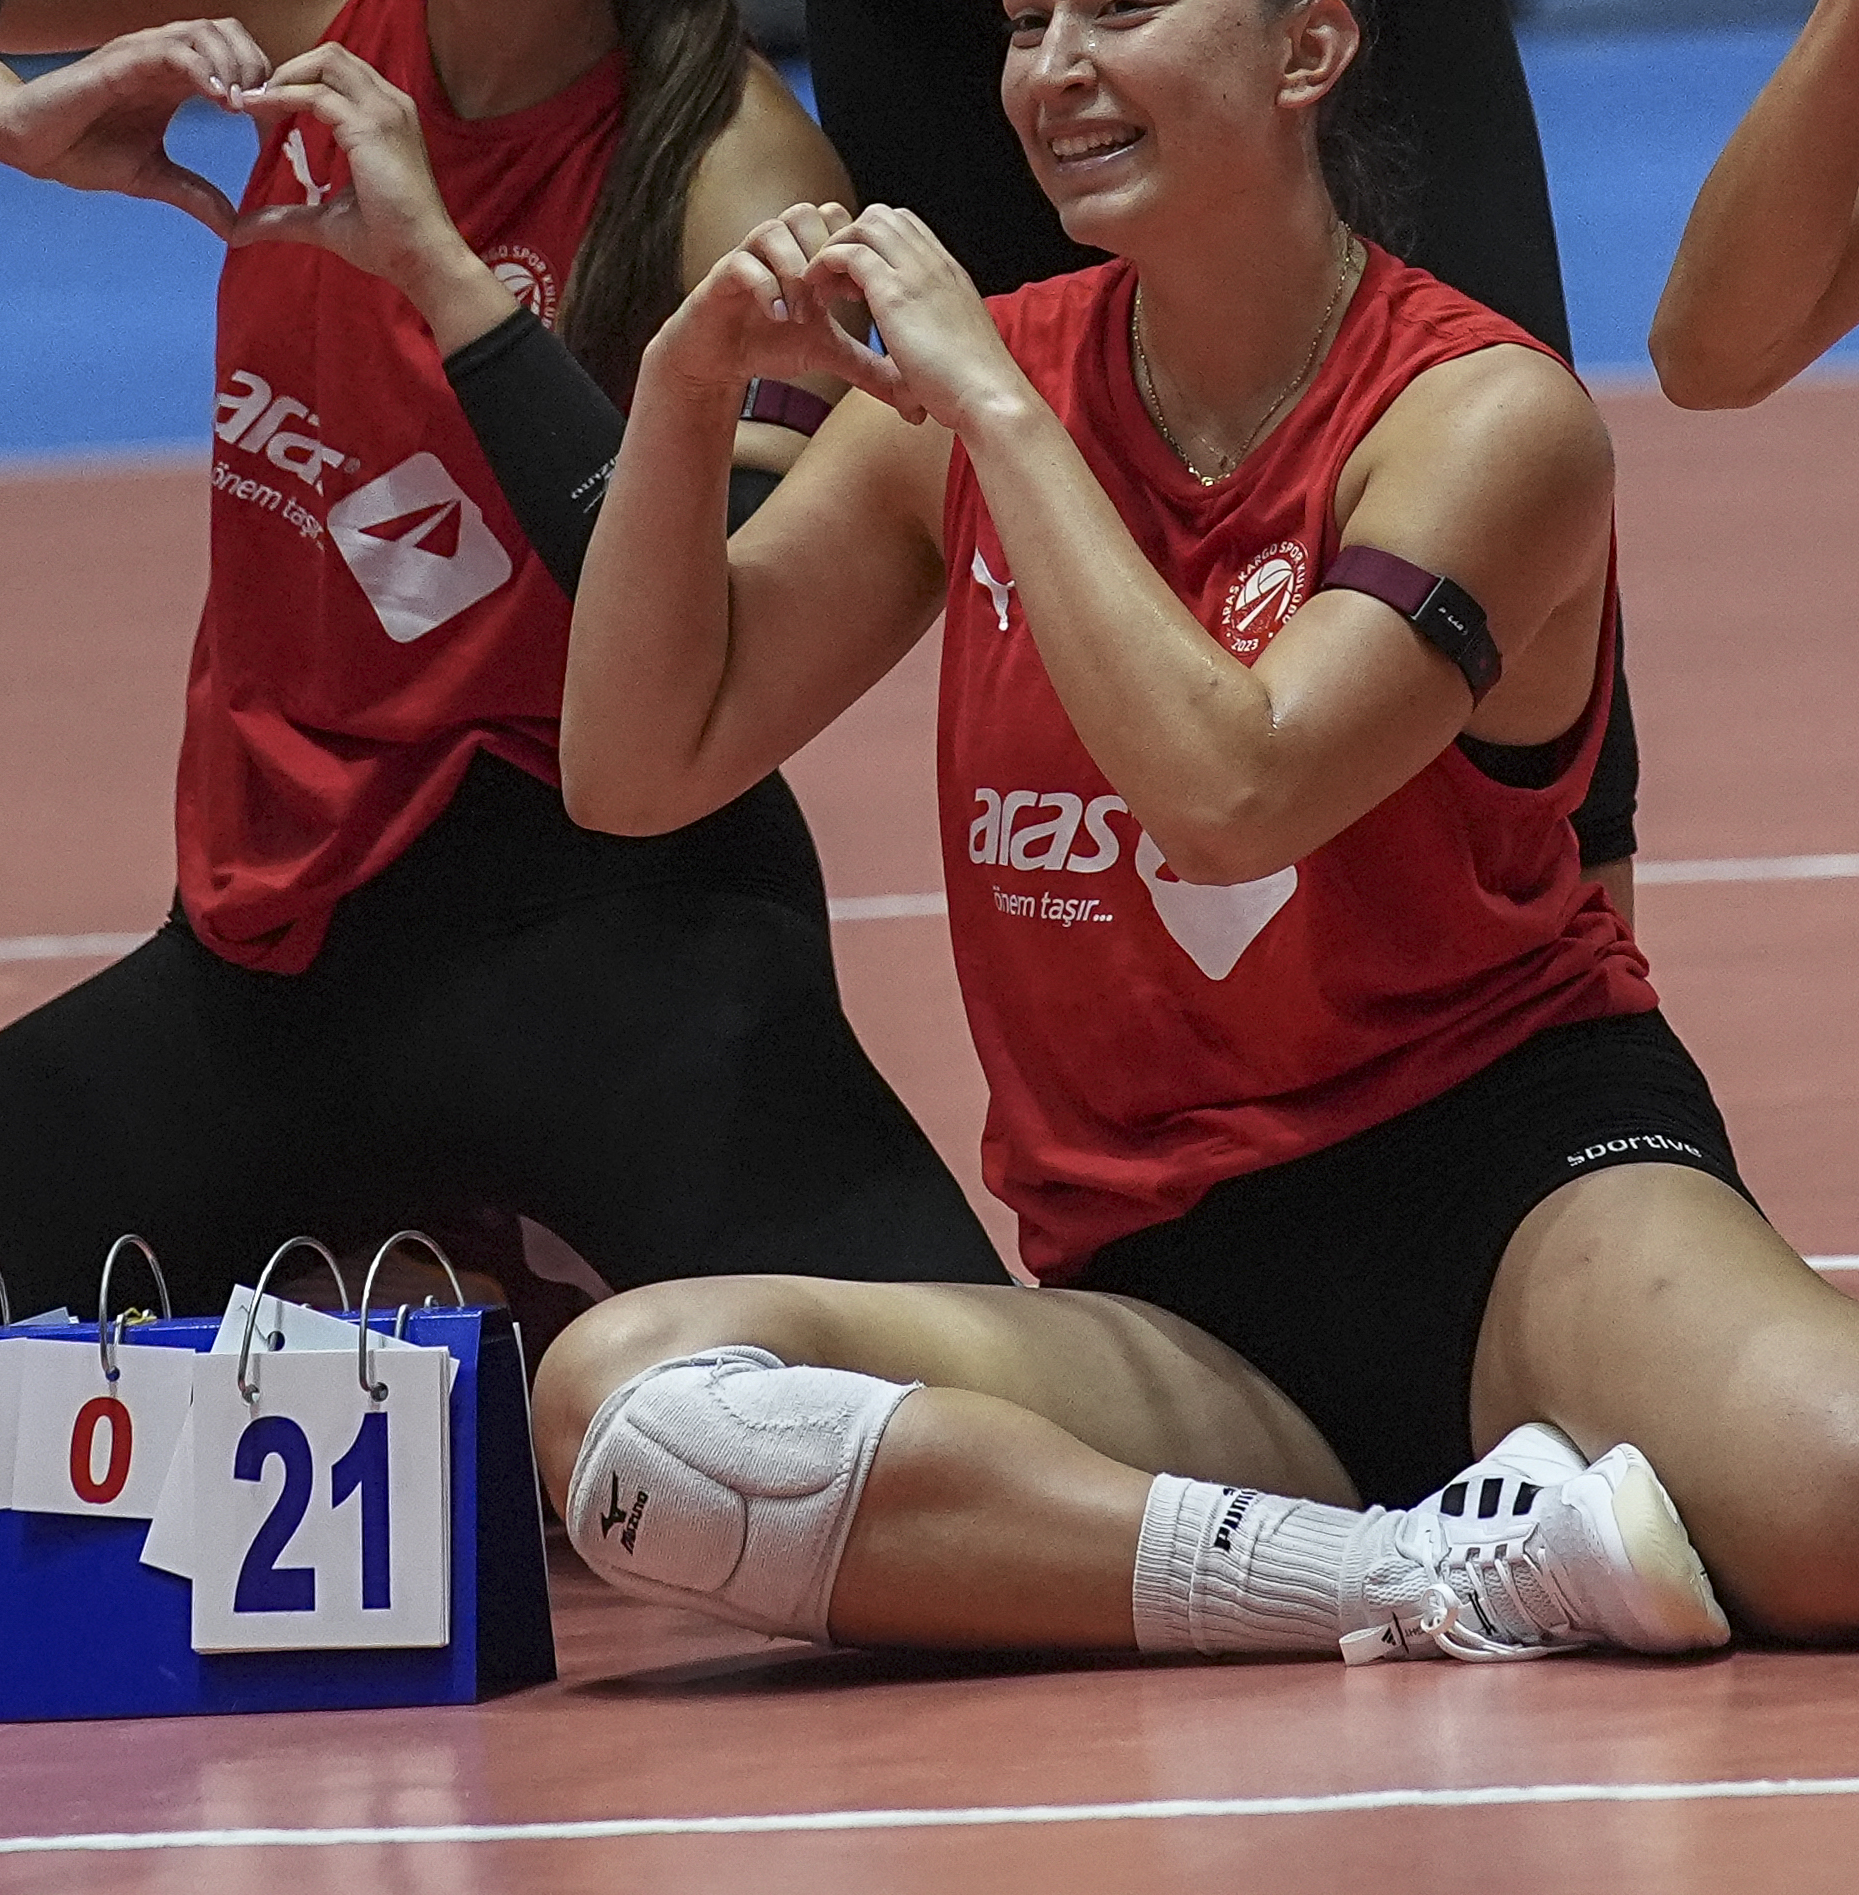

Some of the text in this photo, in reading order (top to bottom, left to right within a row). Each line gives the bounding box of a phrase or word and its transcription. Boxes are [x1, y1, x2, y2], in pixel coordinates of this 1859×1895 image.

[1221, 585, 1240, 624] ARAS
[1238, 543, 1278, 582] KARGO
[1279, 541, 1303, 564] SPOR
[1231, 638, 1259, 652] 2023
[969, 787, 1129, 874] aras
[992, 885, 1035, 918] önem
[1565, 1134, 1703, 1168] sportive
[68, 1397, 133, 1504] 0
[232, 1411, 391, 1612] 21
